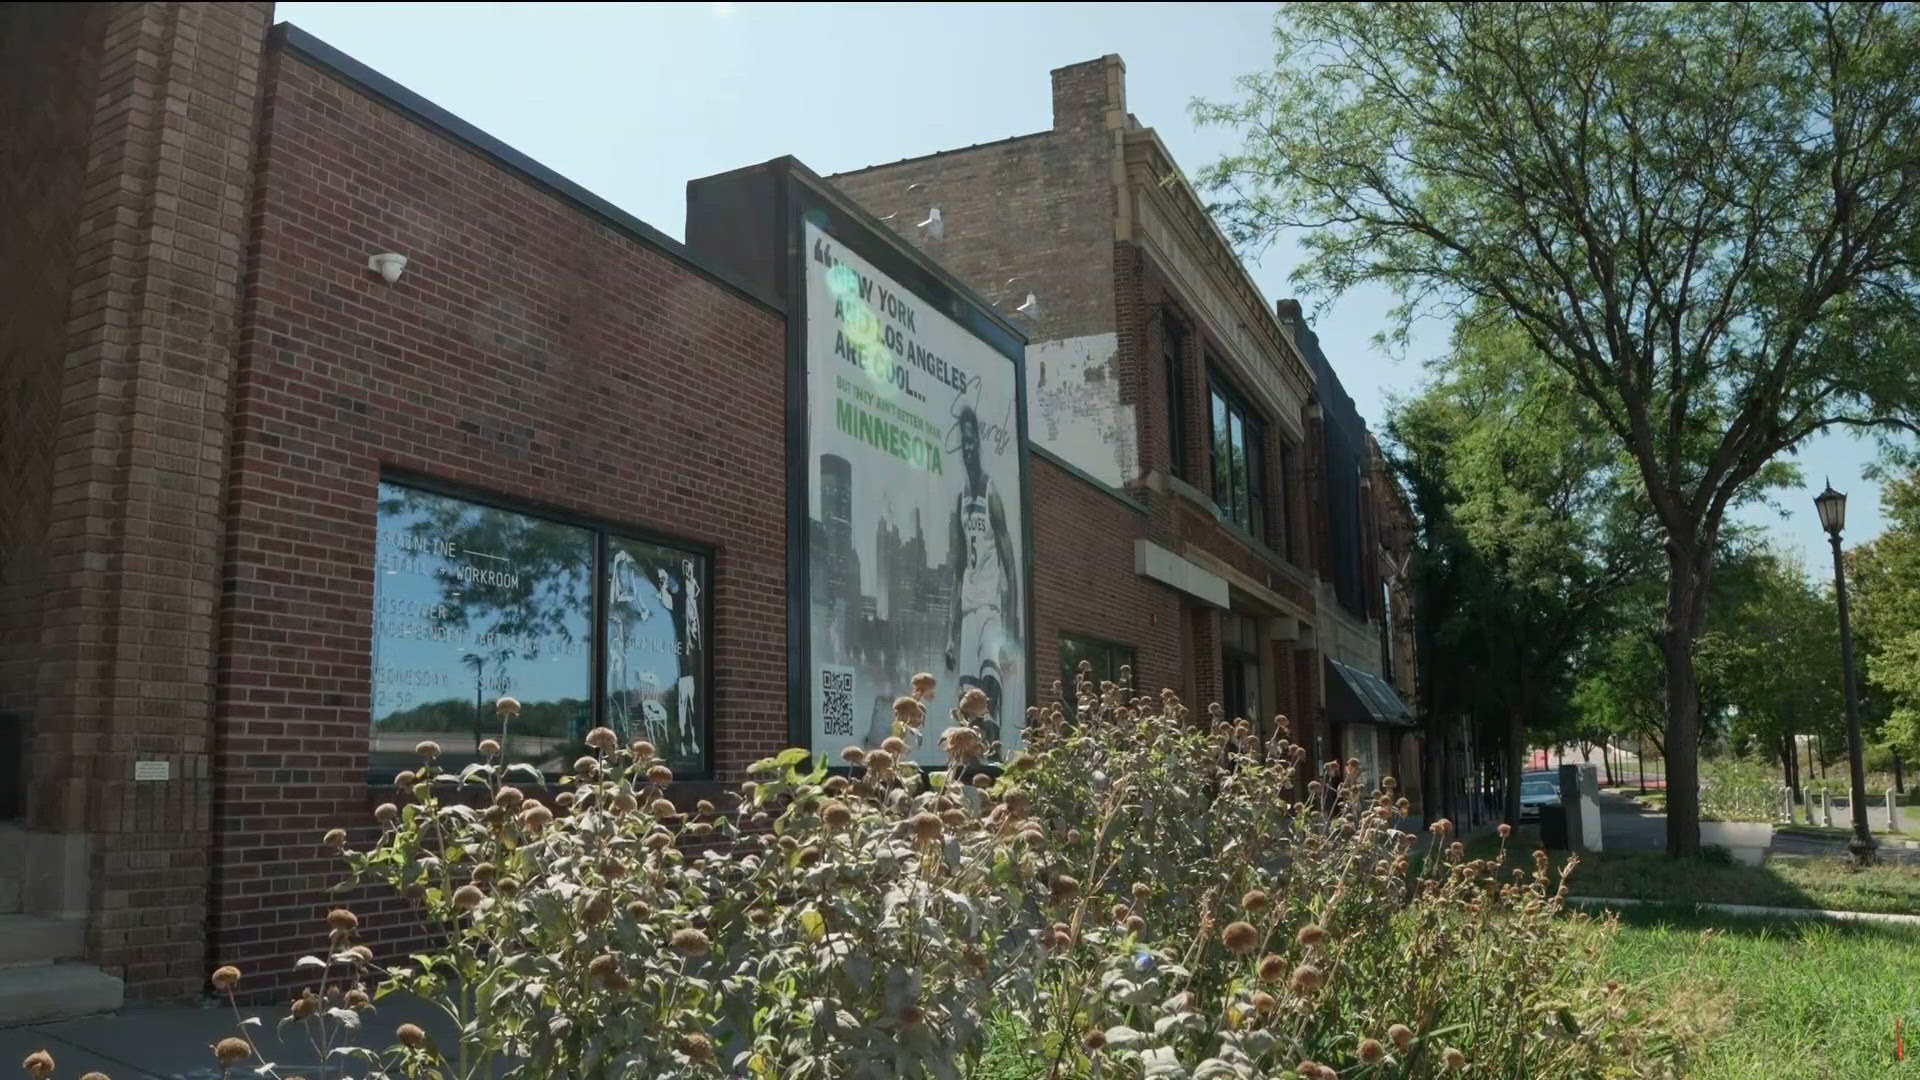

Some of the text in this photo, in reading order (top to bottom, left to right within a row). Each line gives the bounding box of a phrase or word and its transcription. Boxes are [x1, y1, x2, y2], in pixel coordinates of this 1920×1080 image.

[877, 285, 916, 333] YORK
[835, 294, 968, 395] AND LOS ANGELES
[835, 329, 869, 370] ARE
[836, 375, 852, 395] BUT
[853, 385, 874, 406] THEY
[896, 407, 923, 431] BETTER
[836, 397, 943, 476] MINNESOTA
[971, 535, 977, 570] 5
[456, 565, 519, 590] WORKROOM
